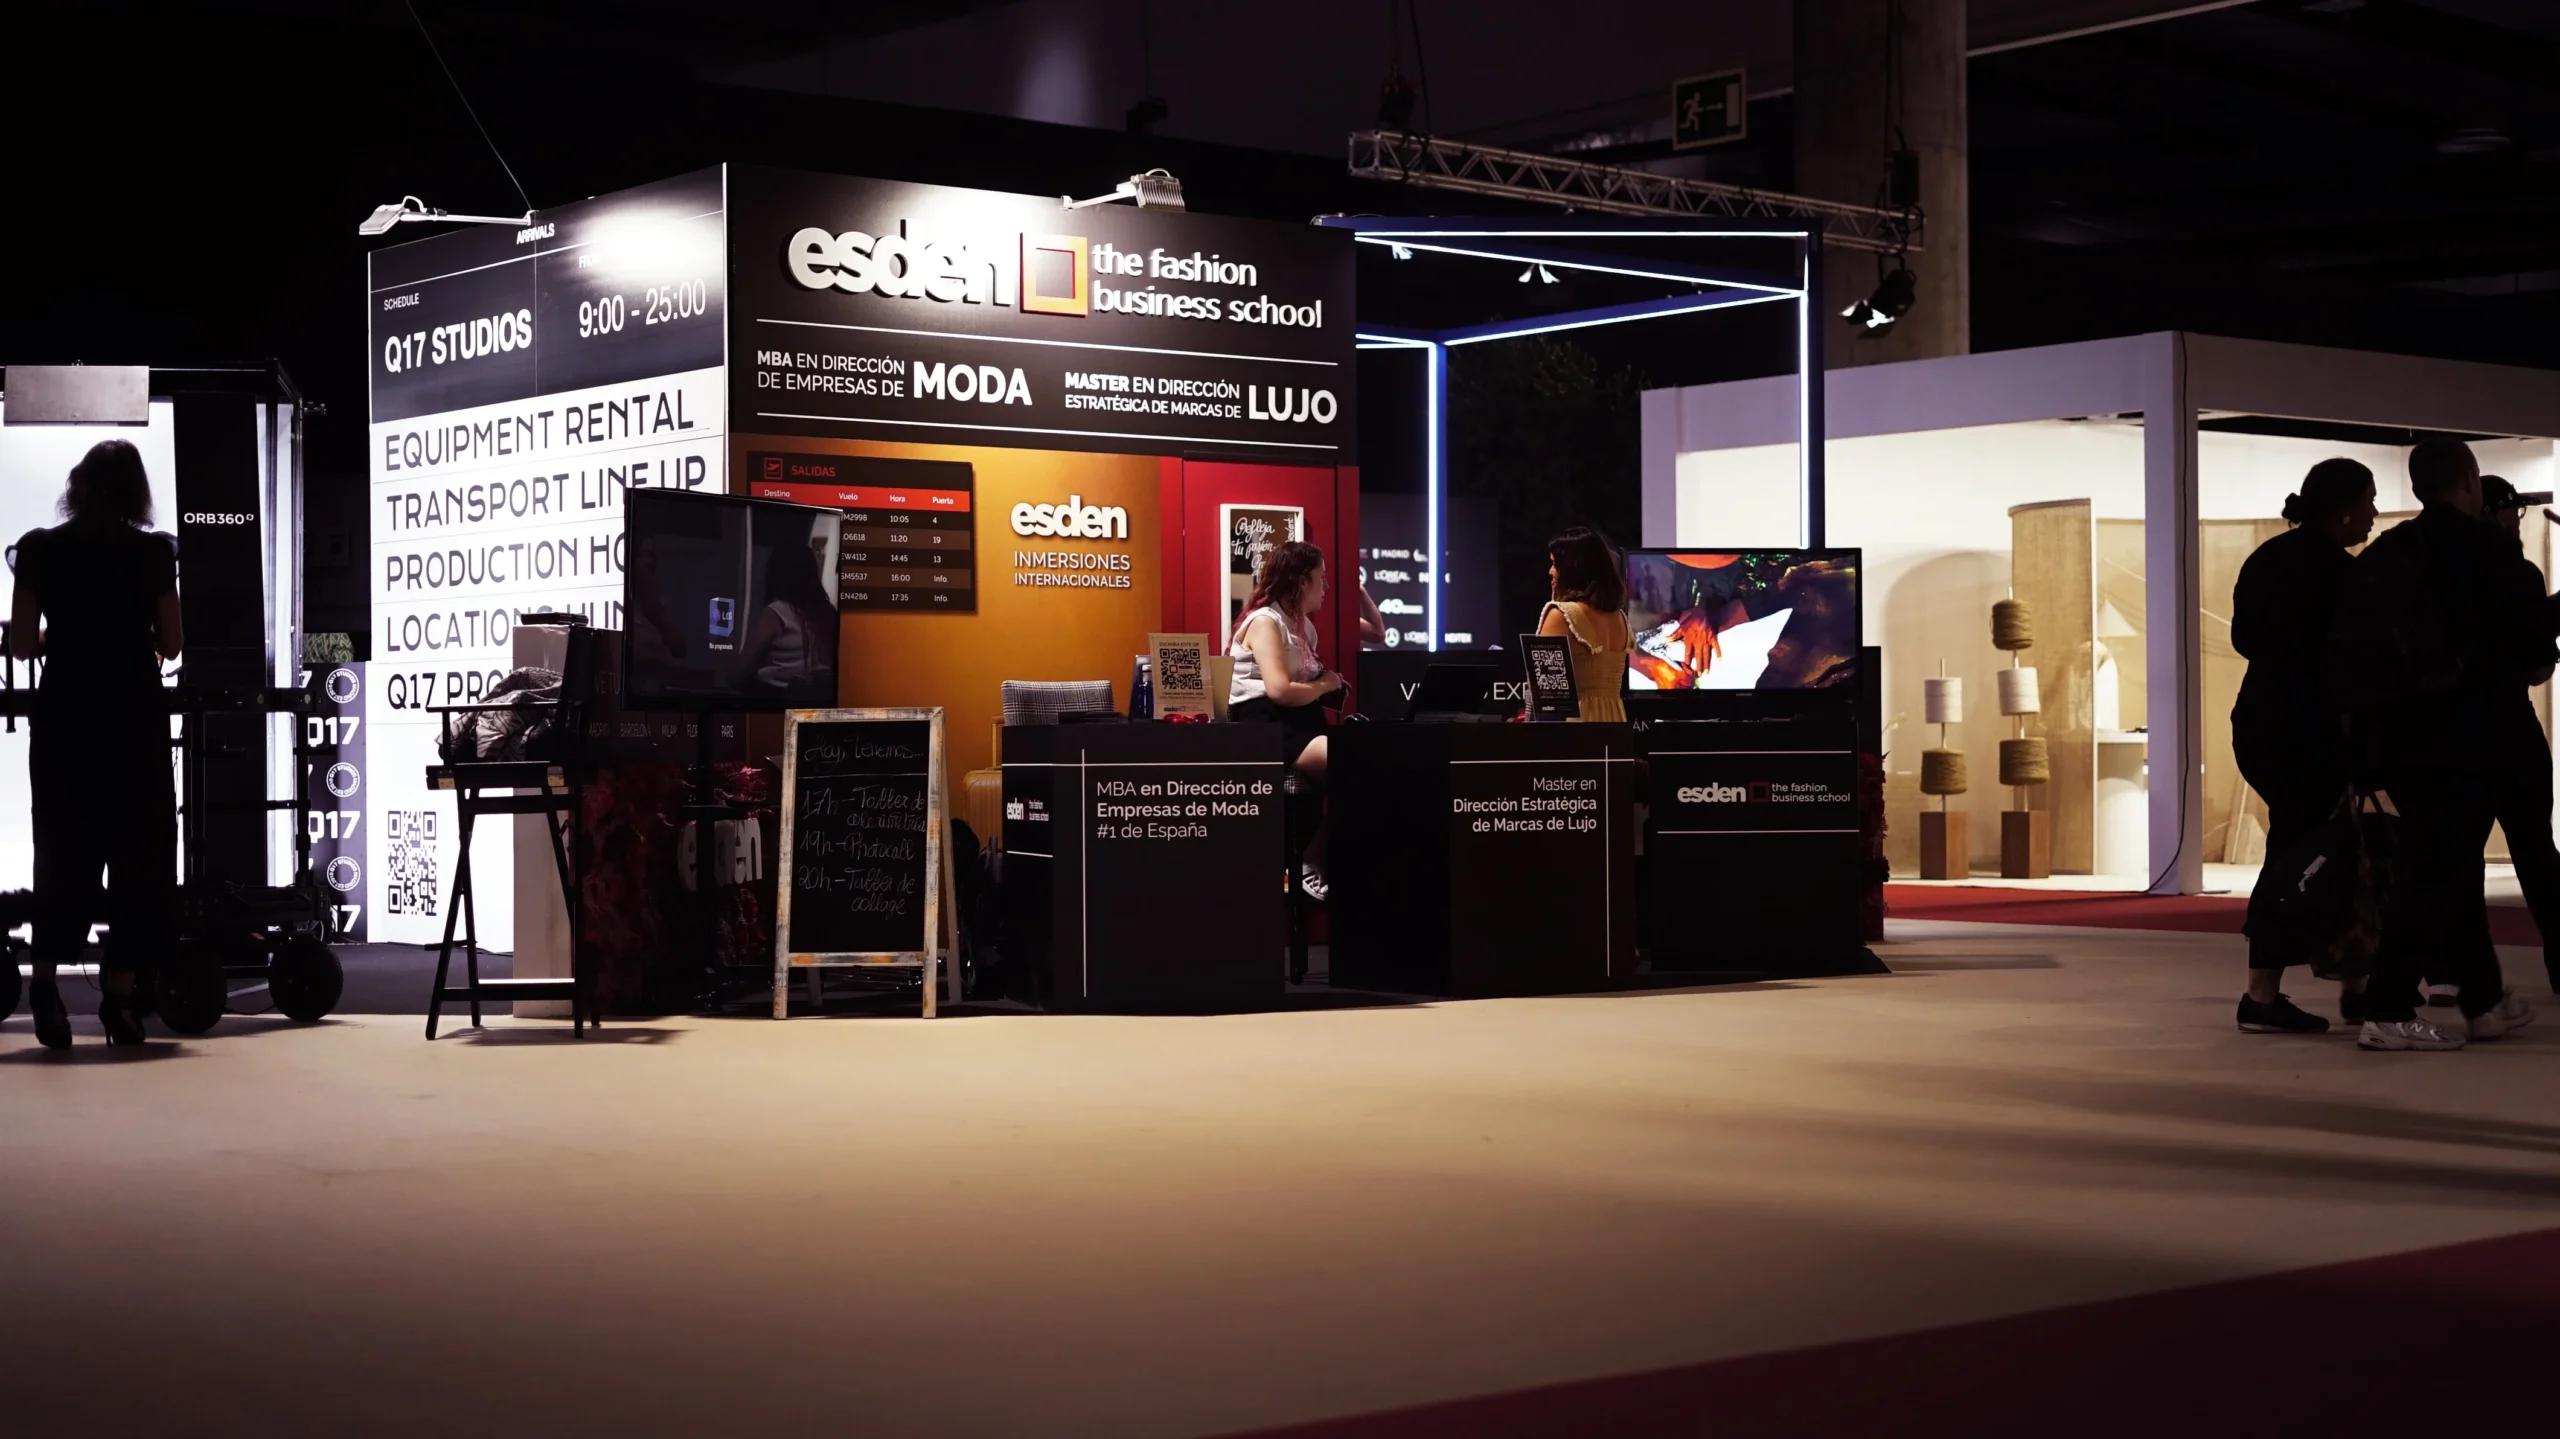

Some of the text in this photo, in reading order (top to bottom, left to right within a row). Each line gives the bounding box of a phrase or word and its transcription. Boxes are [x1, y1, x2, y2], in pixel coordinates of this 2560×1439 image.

[516, 223, 555, 245] ARRIVALS
[788, 218, 1016, 306] esden
[1092, 243, 1257, 287] the fashion
[383, 293, 420, 311] SCHEDULE
[579, 294, 625, 338] 9:00
[645, 278, 706, 325] 25:00
[1093, 280, 1322, 328] business school
[384, 308, 532, 373] Q17 STUDIOS
[757, 350, 905, 375] MBA EN DIRECCIÓN
[757, 361, 1032, 406] DE EMPRESAS DE MODA
[1065, 372, 1240, 399] MASTER EN DIRECCIÓN
[1065, 384, 1338, 424] ESTRATÉGICA DE MARCAS DE LUJO
[386, 389, 694, 471] EQUIPMENT RENTAL
[791, 464, 836, 477] SALIDAS
[387, 455, 706, 531] TRANSPORT LINE UP
[764, 489, 954, 505] Destino Vuelo Hora Puerta
[890, 515, 909, 523] 10:05
[932, 516, 937, 524] 4
[1010, 495, 1128, 539] esden
[890, 535, 908, 543] 11:20
[933, 536, 941, 544] 19
[387, 537, 578, 592] PRODUCTION
[890, 554, 909, 562] 14:45
[1014, 551, 1131, 571] INMERSIONES
[891, 574, 910, 582] 16:00
[1014, 573, 1131, 588] INTERNACIONALES
[840, 592, 868, 600] EN4286
[388, 672, 436, 709] Q17
[1097, 780, 1273, 797] MBA en Dirección de
[1533, 777, 1597, 791] Master en
[1677, 782, 1747, 803] esden
[1772, 783, 1827, 792] the fashion
[852, 784, 909, 811] Taller
[911, 790, 926, 811] de
[1453, 796, 1597, 814] Dirección Estratégica
[1772, 792, 1851, 802] business school
[1007, 797, 1024, 820] esden
[1097, 801, 1260, 821] Empresas de Moda
[1097, 822, 1208, 841] #1 de España
[1472, 816, 1597, 832] de Marcas de Lujo
[844, 867, 893, 892] Taller
[897, 872, 916, 894] de
[851, 893, 907, 921] collage
